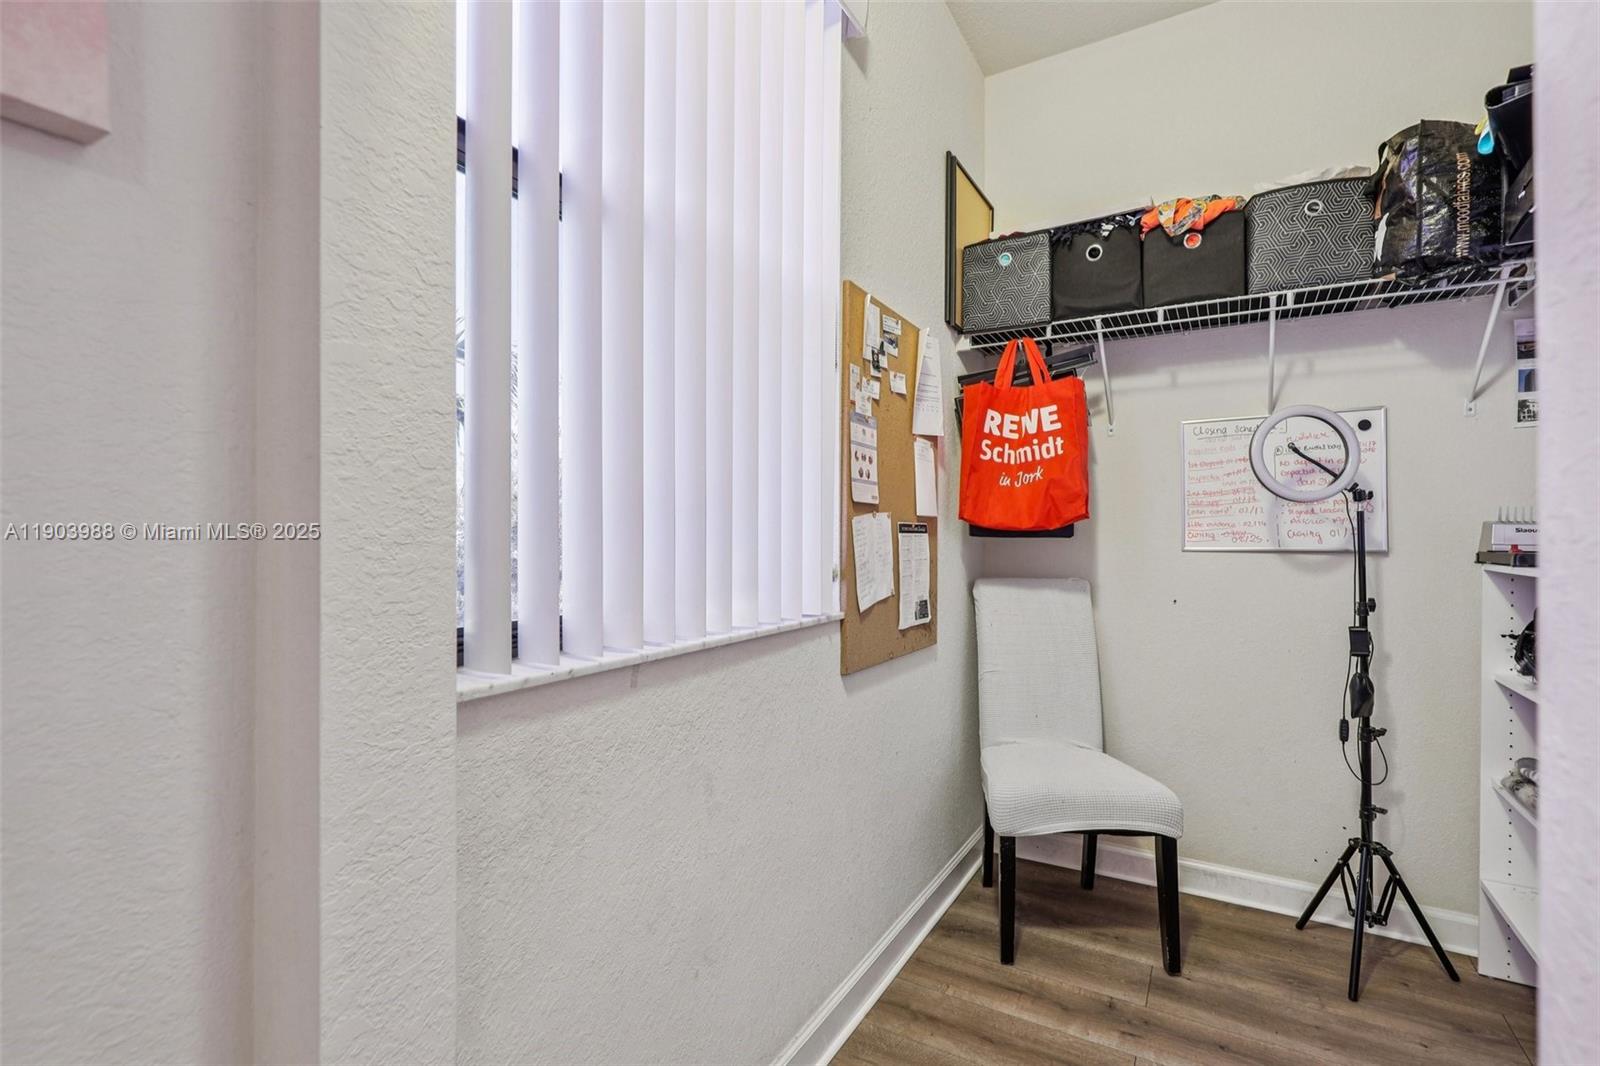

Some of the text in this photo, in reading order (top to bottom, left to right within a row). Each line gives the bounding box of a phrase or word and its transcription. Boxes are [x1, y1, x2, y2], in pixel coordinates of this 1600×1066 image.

[983, 404, 1062, 439] RENE
[979, 435, 1064, 465] Schmidt
[999, 465, 1044, 488] in Jork
